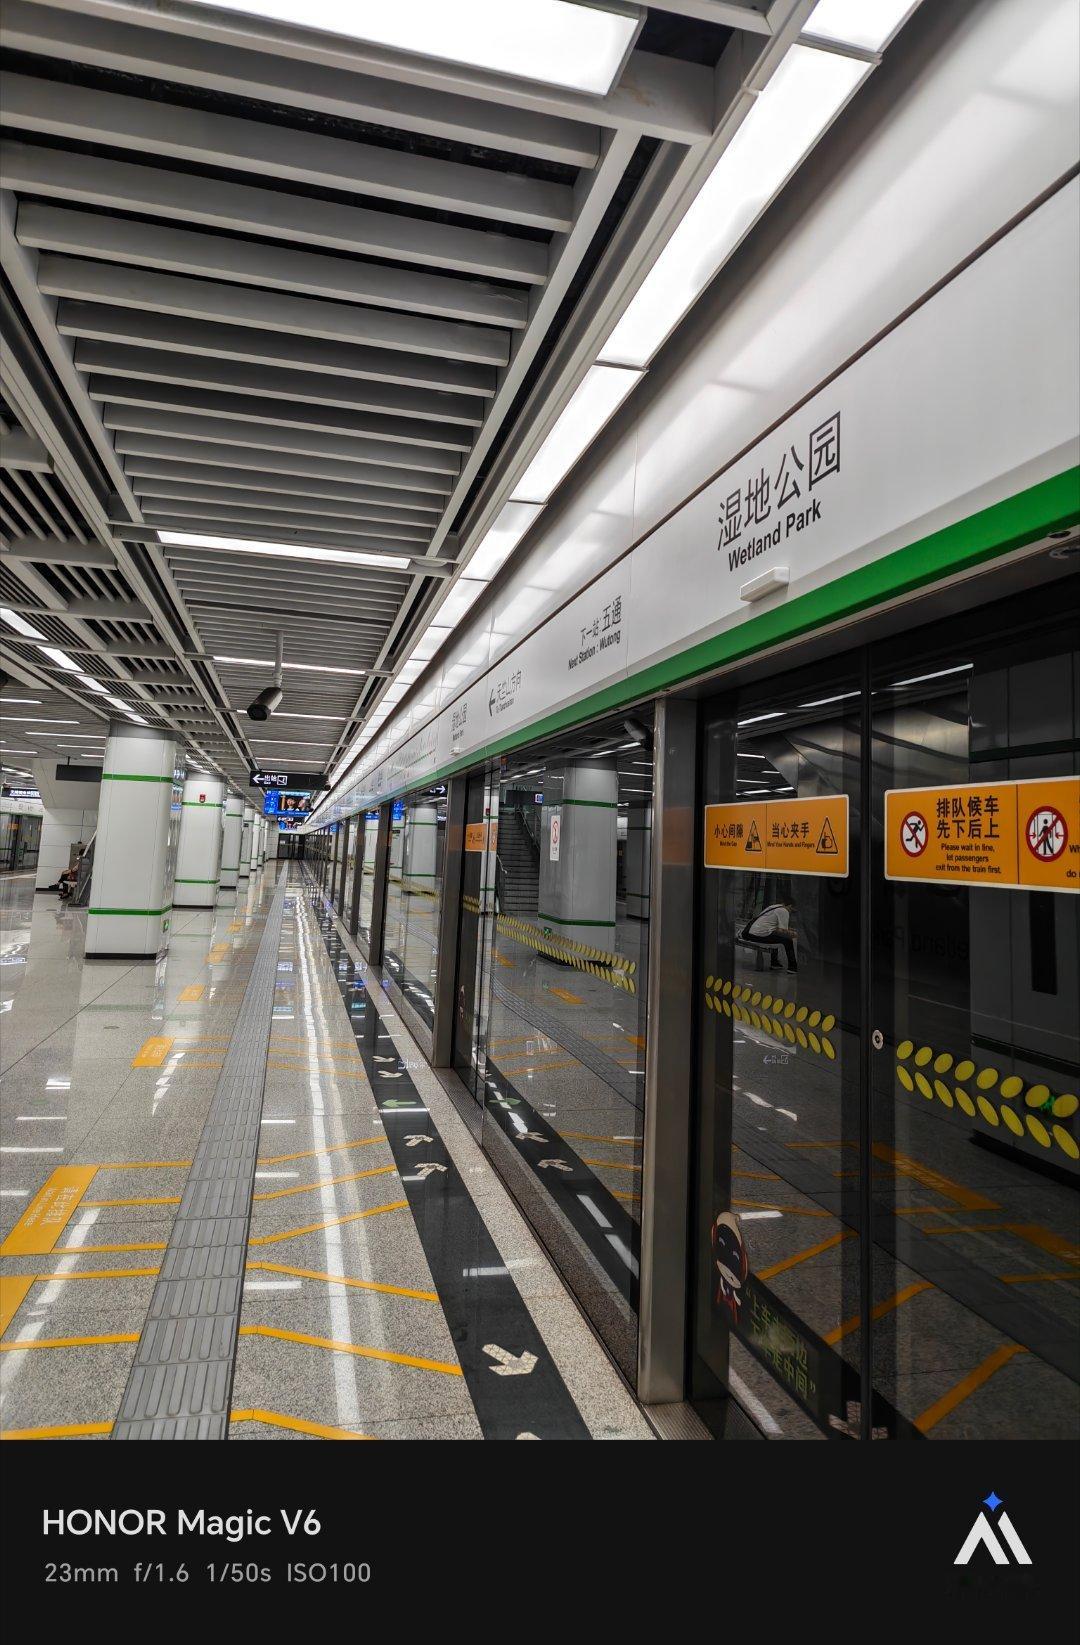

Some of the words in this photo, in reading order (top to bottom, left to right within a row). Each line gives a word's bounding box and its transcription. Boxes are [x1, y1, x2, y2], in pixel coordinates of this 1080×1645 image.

[718, 411, 841, 551] 湿地公园
[728, 521, 781, 572] Wetland
[785, 498, 822, 538] Park
[936, 795, 1000, 818] 排队候车
[714, 823, 744, 839] 小心间隙
[772, 822, 810, 840] 当心夹手
[936, 818, 1000, 839] 先下后上
[940, 843, 960, 852] Please
[960, 843, 973, 852] wait
[974, 843, 981, 852] in
[935, 863, 946, 871] exit
[946, 864, 961, 872] from
[961, 864, 971, 873] the
[972, 865, 987, 873] train
[954, 855, 989, 864] passengers
[1066, 869, 1077, 878] do
